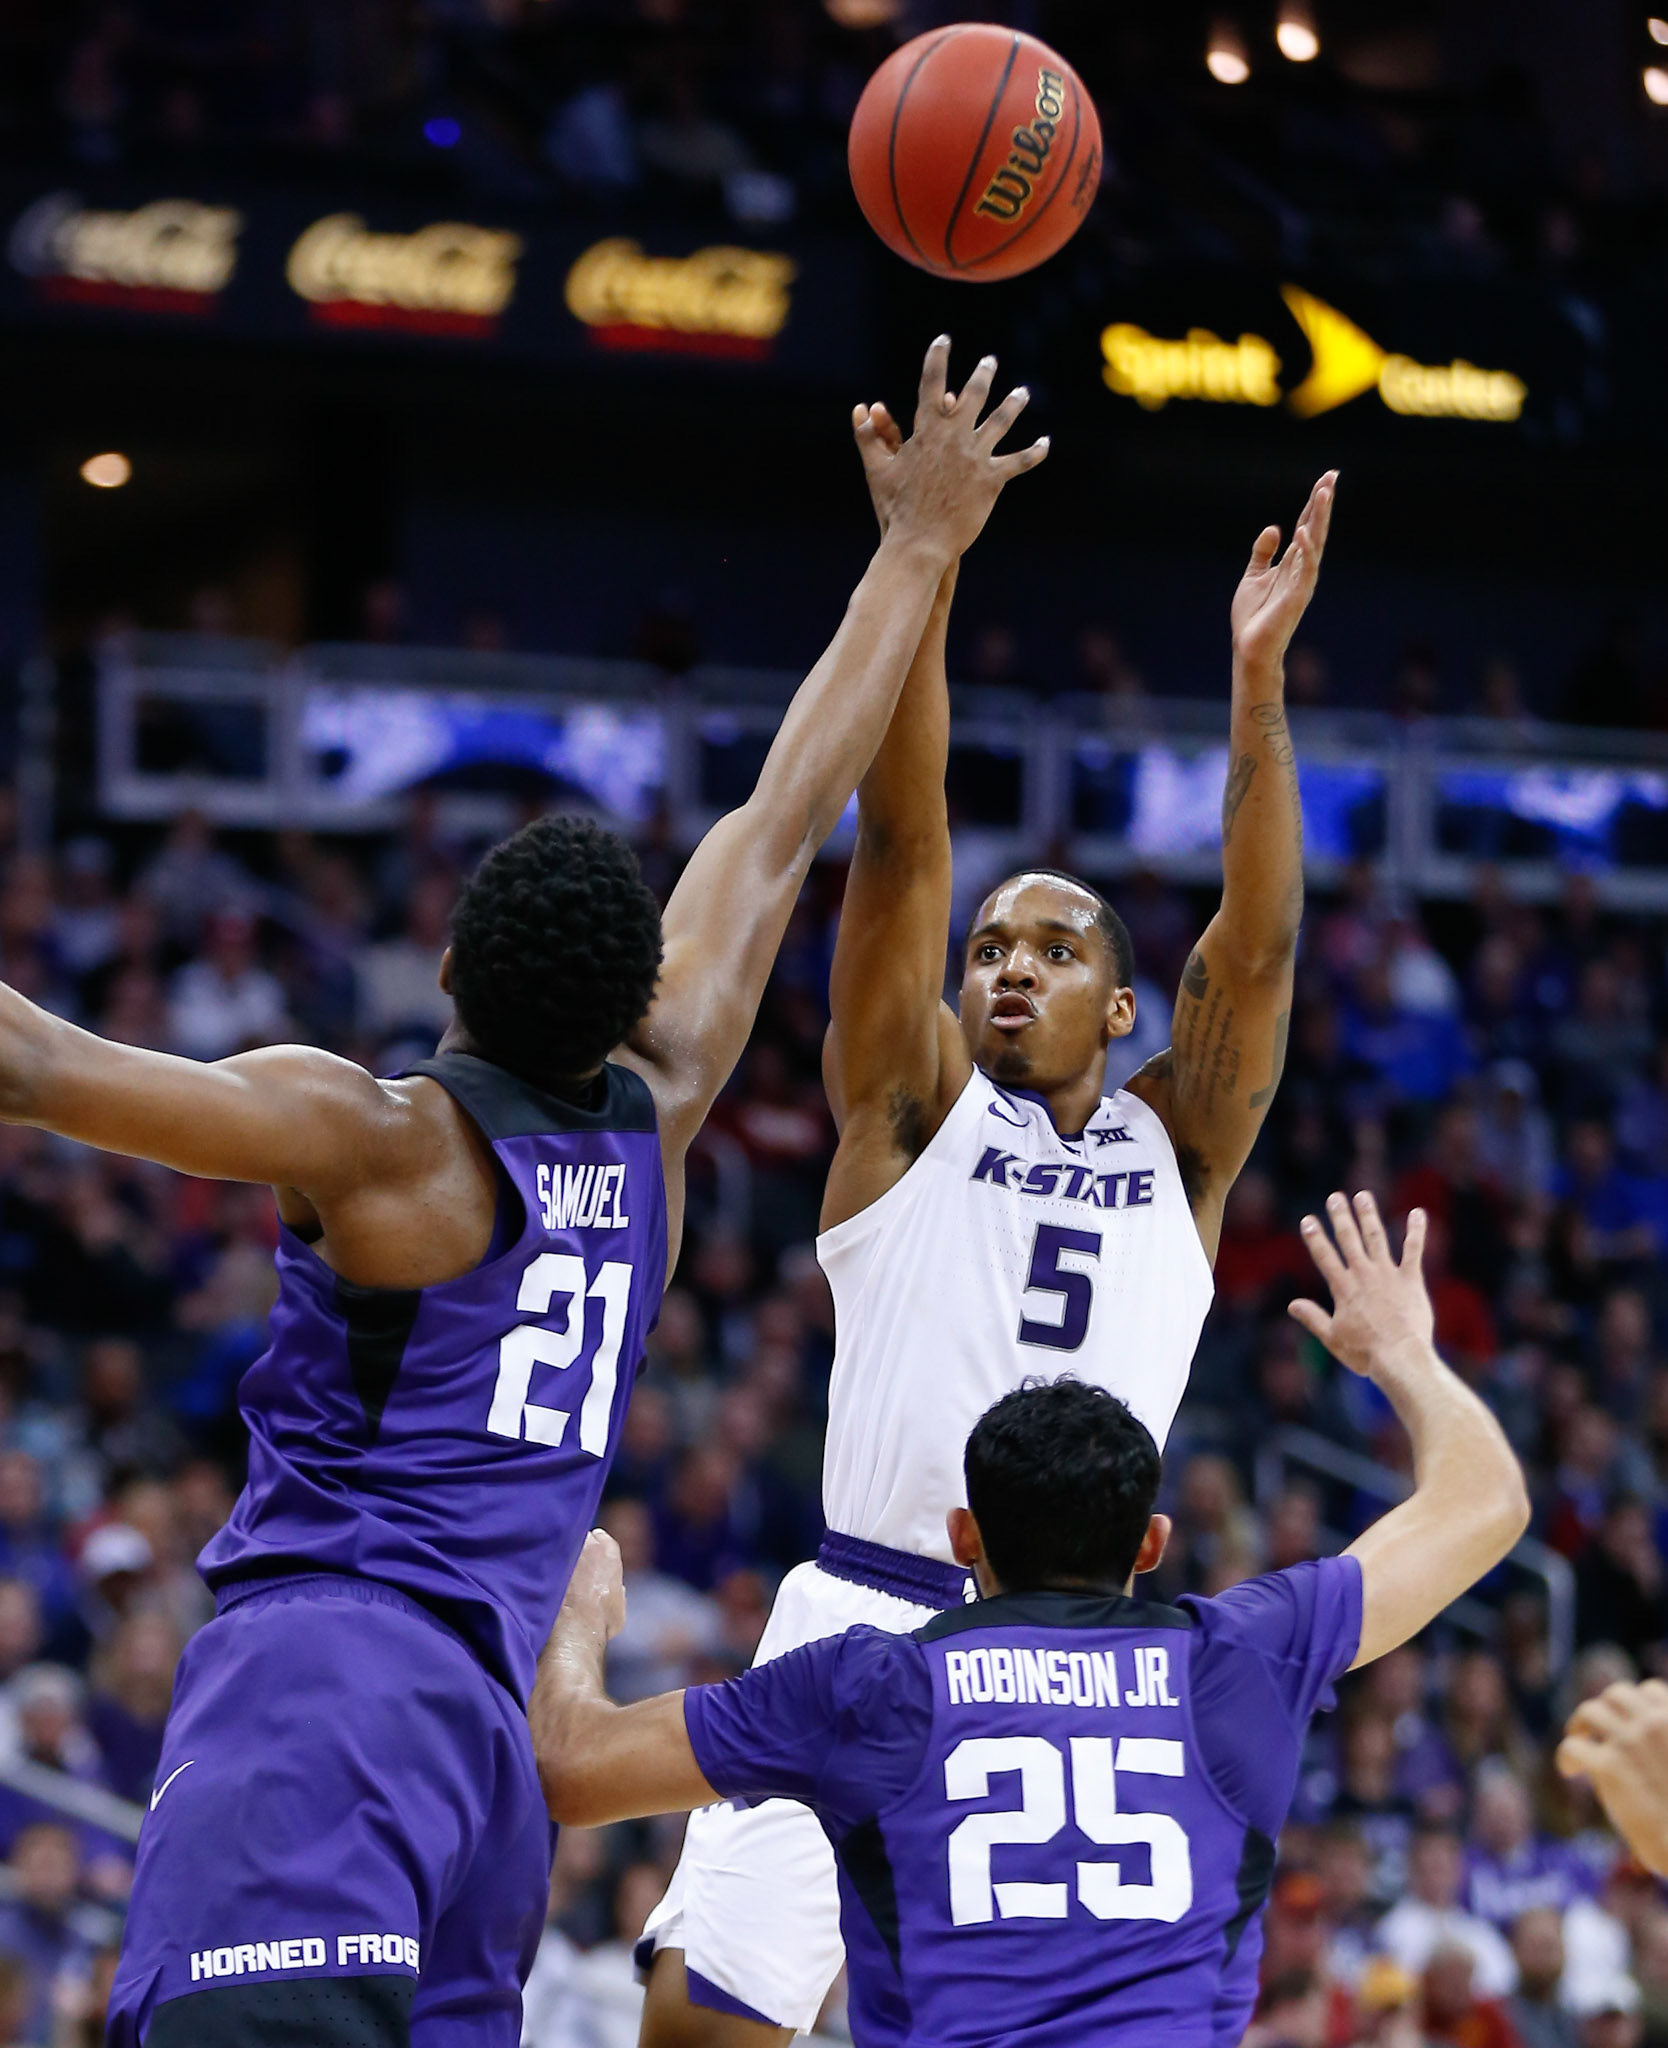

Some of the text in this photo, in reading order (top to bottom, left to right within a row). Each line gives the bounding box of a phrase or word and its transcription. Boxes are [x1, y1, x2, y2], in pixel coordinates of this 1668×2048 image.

[973, 67, 1064, 223] Wilson
[536, 1163, 629, 1230] SAMUEL
[969, 1144, 1155, 1209] K-STATE
[1016, 1221, 1103, 1354] 5
[486, 1252, 633, 1458] 21
[945, 1647, 1180, 1708] ROBINSON JR.
[944, 1736, 1193, 1927] 25
[190, 1933, 420, 1982] HORNED FROG
